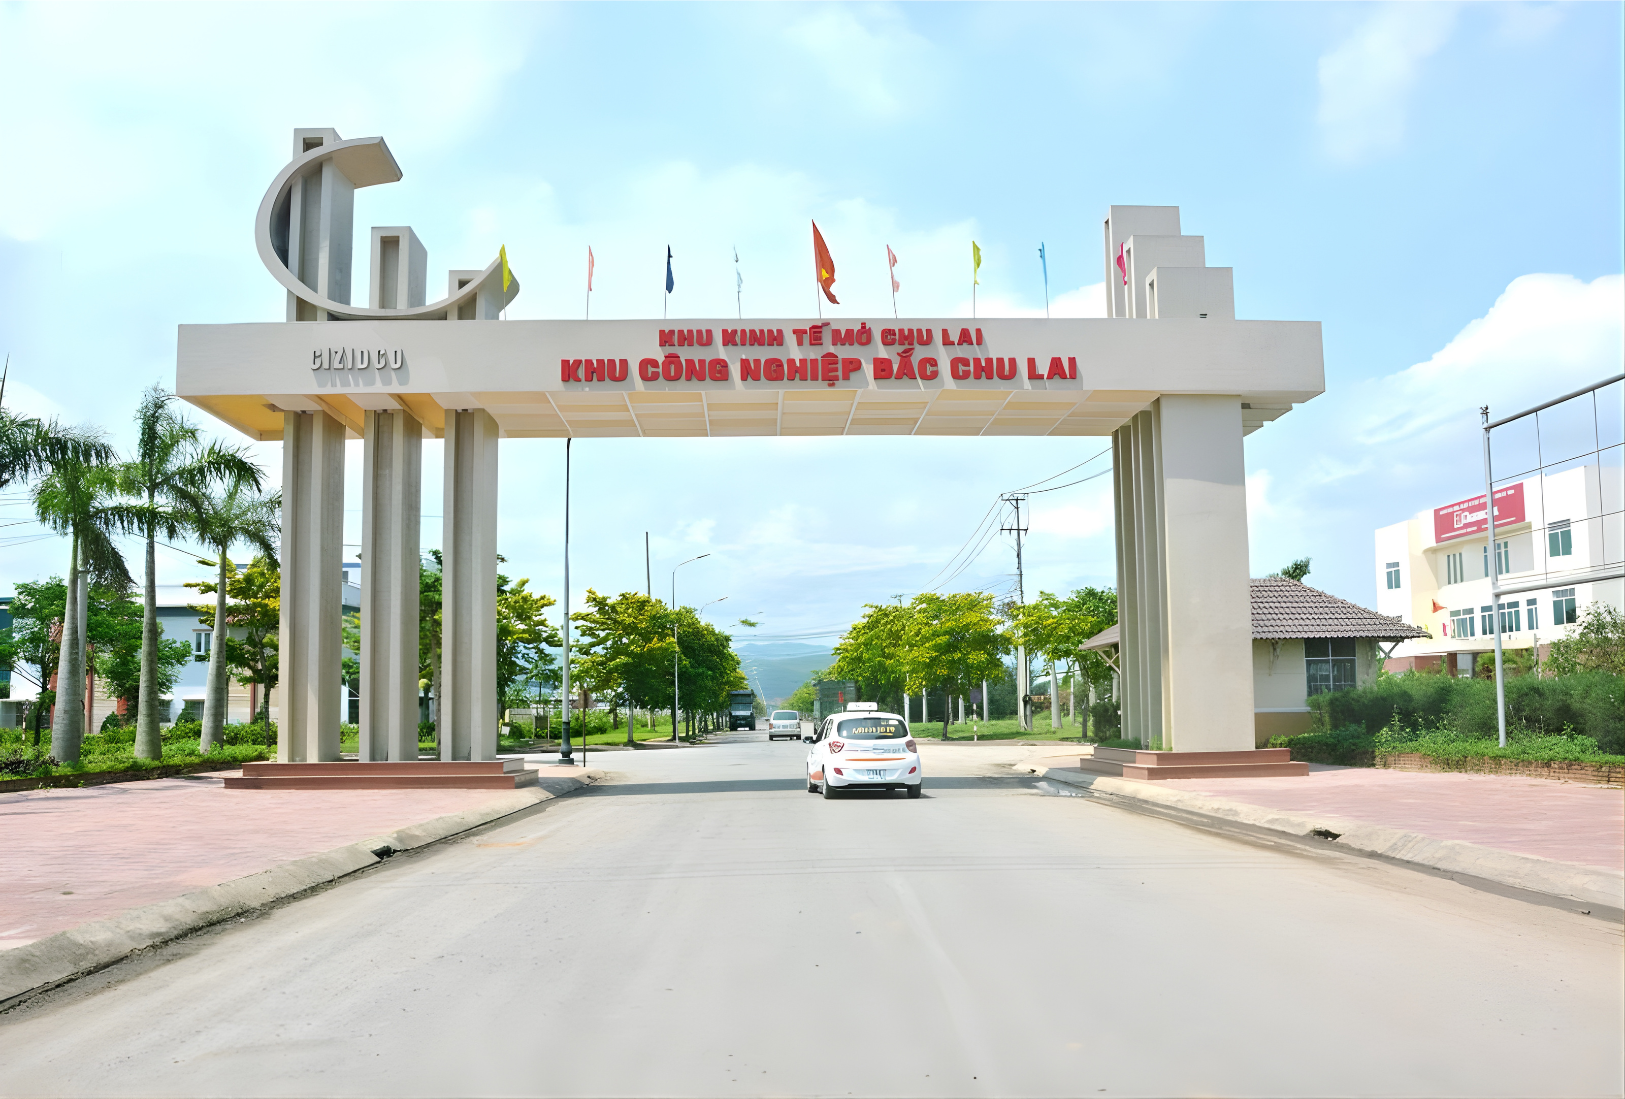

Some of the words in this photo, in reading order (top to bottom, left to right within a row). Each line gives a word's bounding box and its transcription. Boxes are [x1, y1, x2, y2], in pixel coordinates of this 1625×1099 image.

[658, 328, 713, 347] KHU
[721, 328, 784, 347] KINH
[791, 321, 831, 346] TẾ
[880, 327, 933, 347] CHU
[941, 327, 983, 346] LAI
[560, 357, 629, 382] KHU
[638, 352, 729, 382] CÔNG
[739, 351, 863, 387] NGHIỆP
[872, 347, 939, 381] BẮC
[949, 356, 1017, 380] CHU
[1026, 356, 1077, 380] LAI
